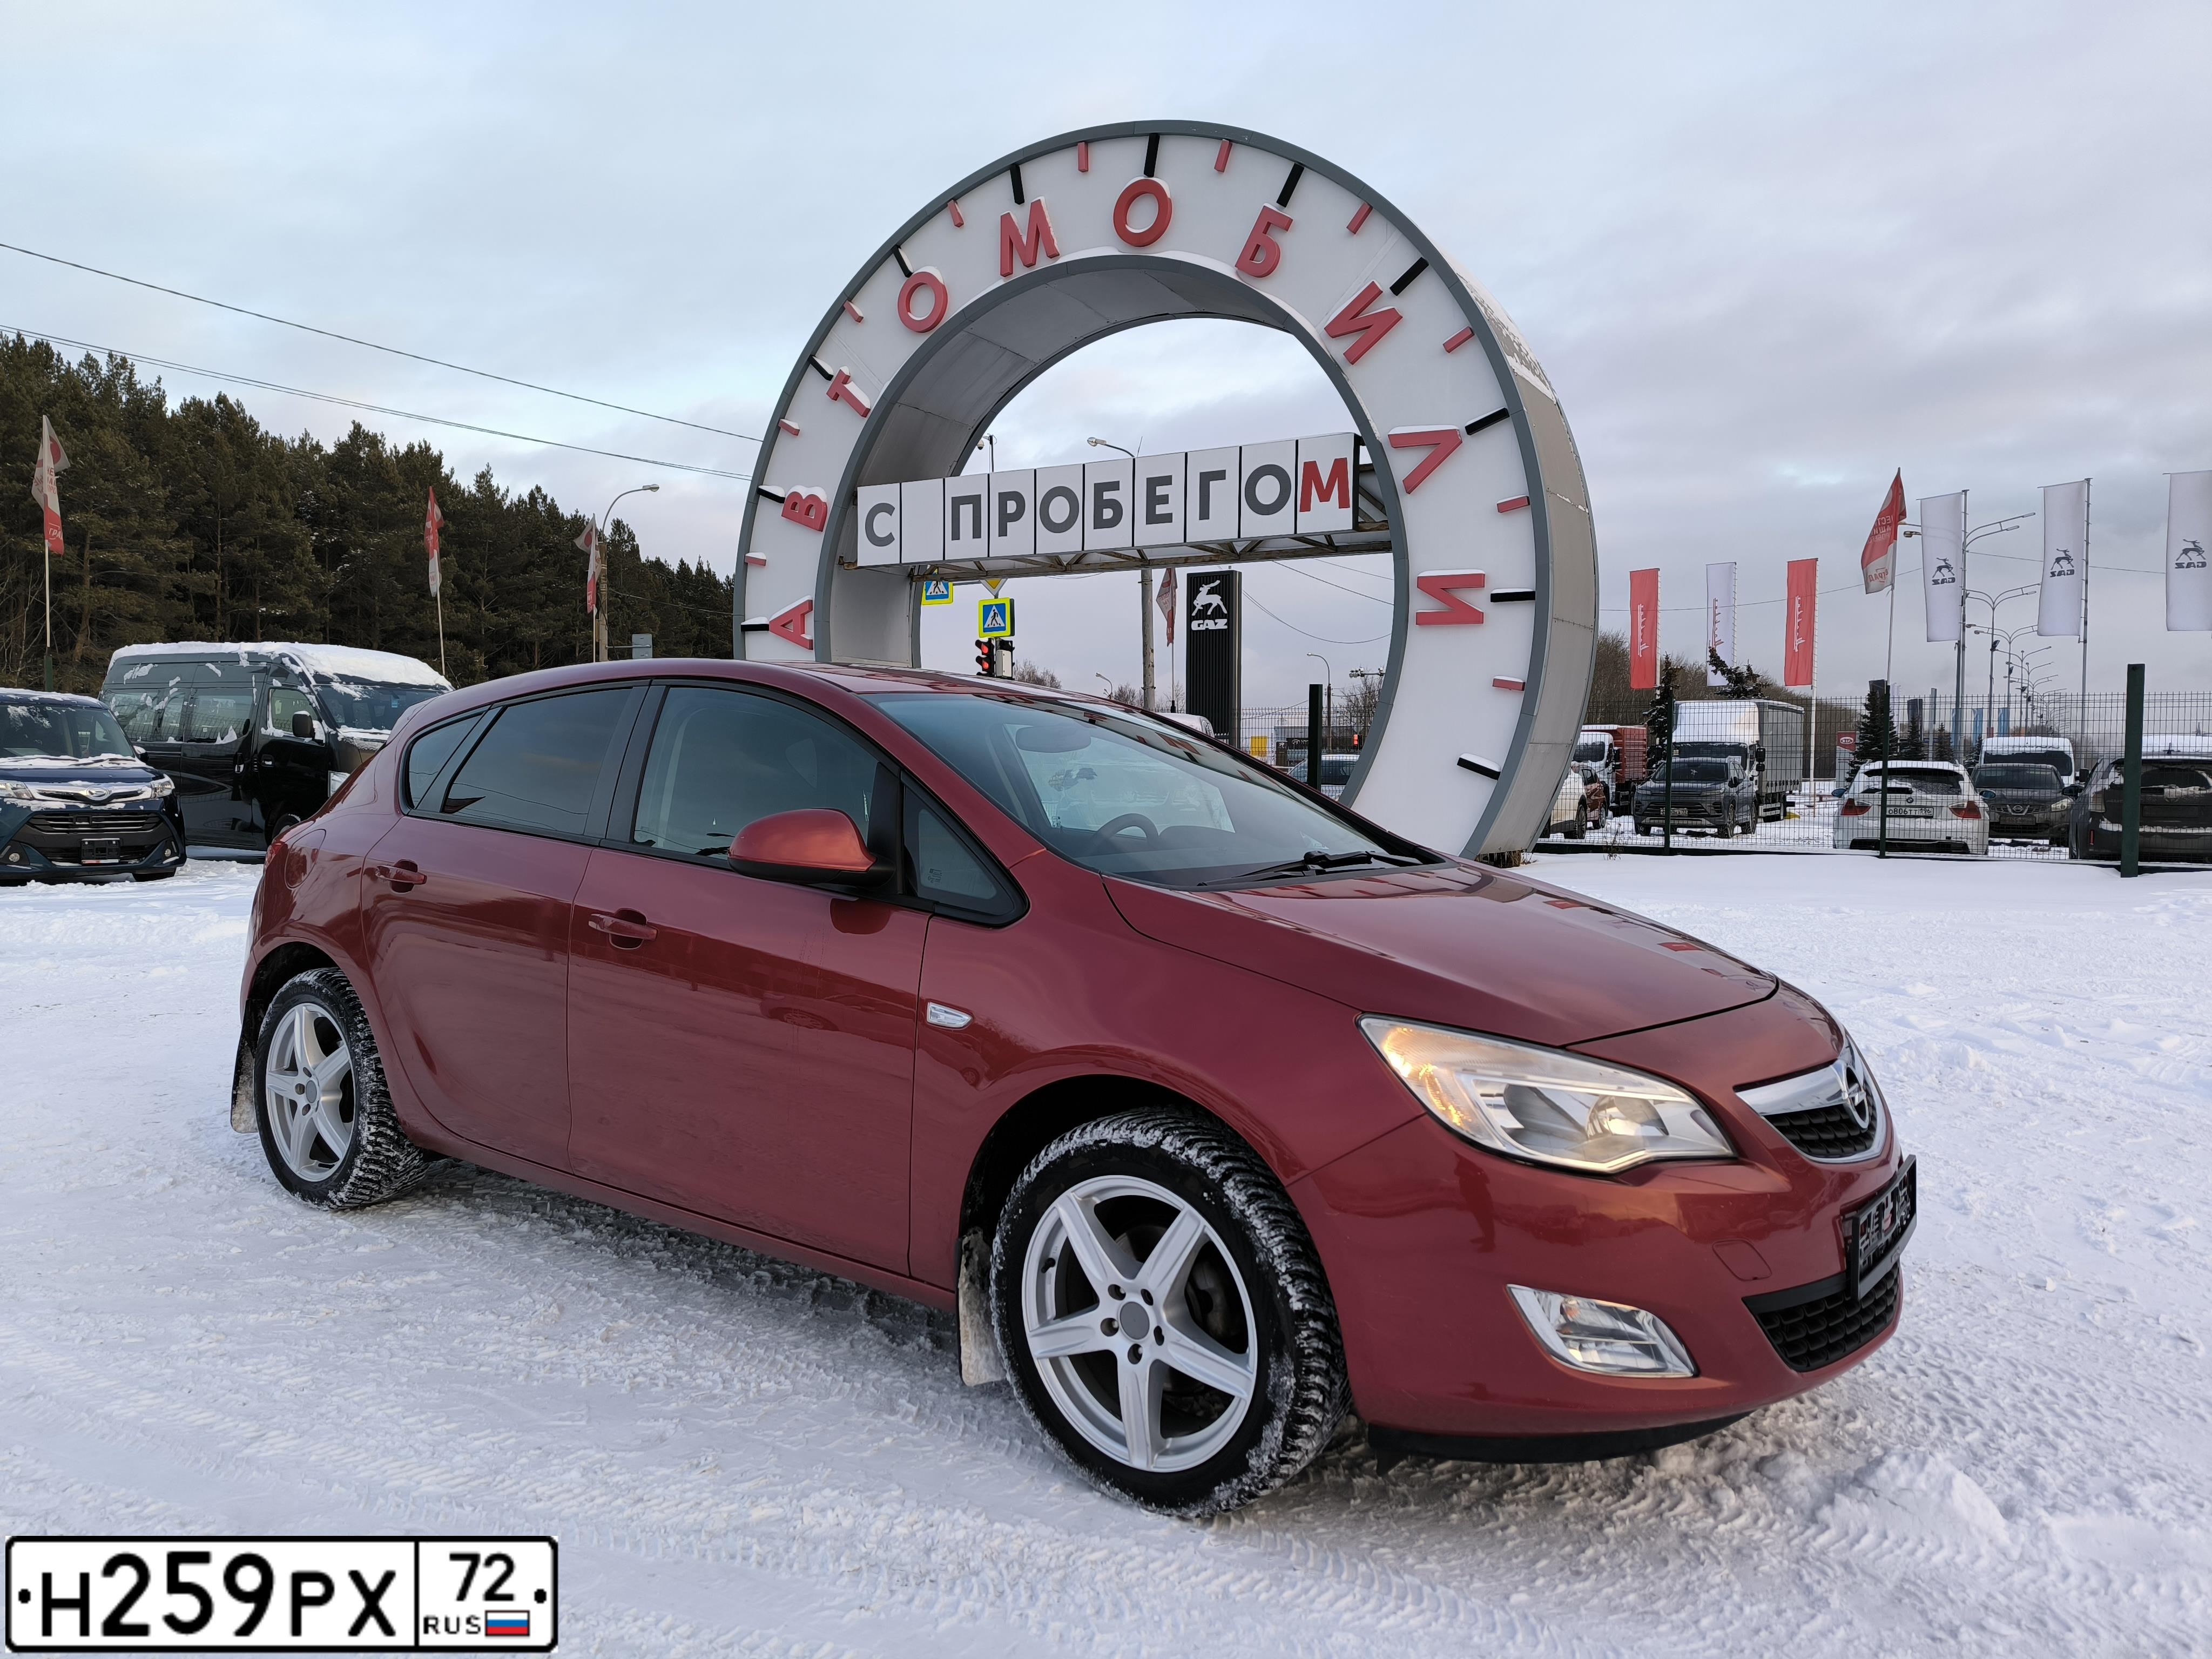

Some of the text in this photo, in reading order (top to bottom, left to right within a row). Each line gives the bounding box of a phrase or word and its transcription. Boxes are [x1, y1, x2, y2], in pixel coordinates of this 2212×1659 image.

[769, 178, 1486, 650] АВТОМОБИЛИ
[865, 457, 1351, 547] С ПРОБЕГОМ
[1191, 618, 1228, 631] GAZ
